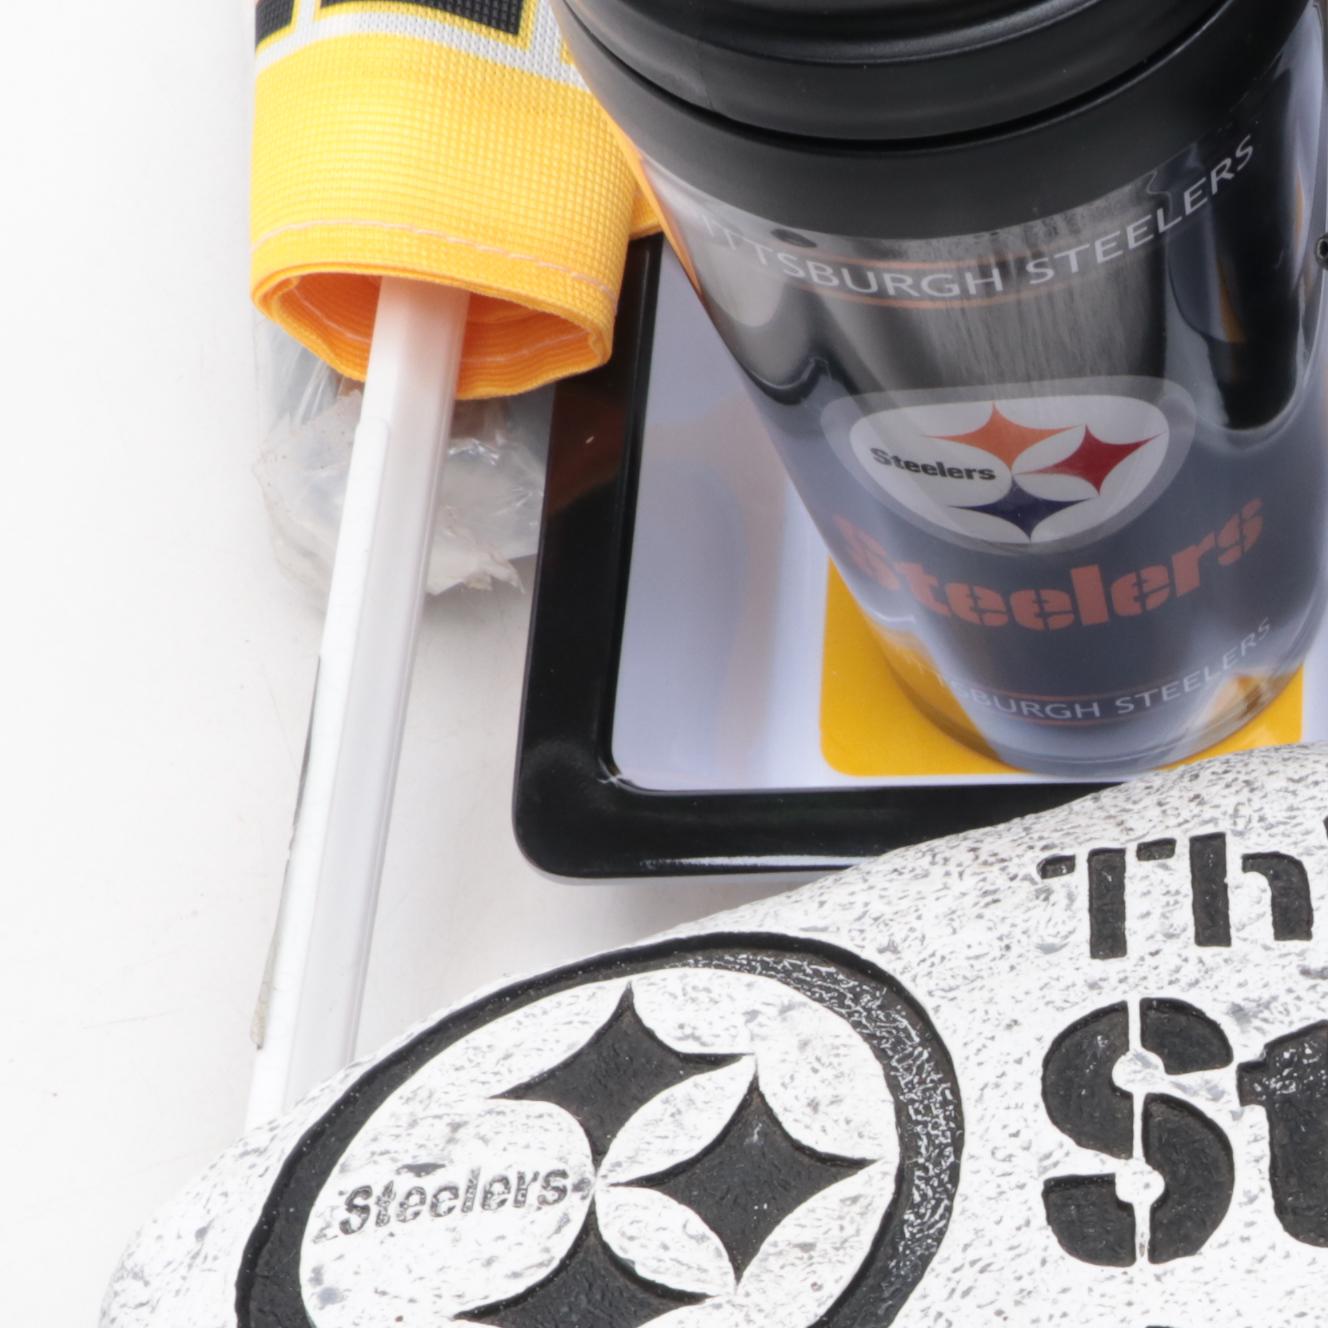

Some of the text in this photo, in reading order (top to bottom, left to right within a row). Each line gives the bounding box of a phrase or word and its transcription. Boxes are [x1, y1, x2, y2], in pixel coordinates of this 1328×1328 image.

[1025, 134, 1254, 284] STEELERS
[869, 447, 997, 481] Steelers
[832, 498, 1264, 631] Steelers
[1115, 616, 1272, 715] STEELERS
[338, 1166, 569, 1236] Steelers
